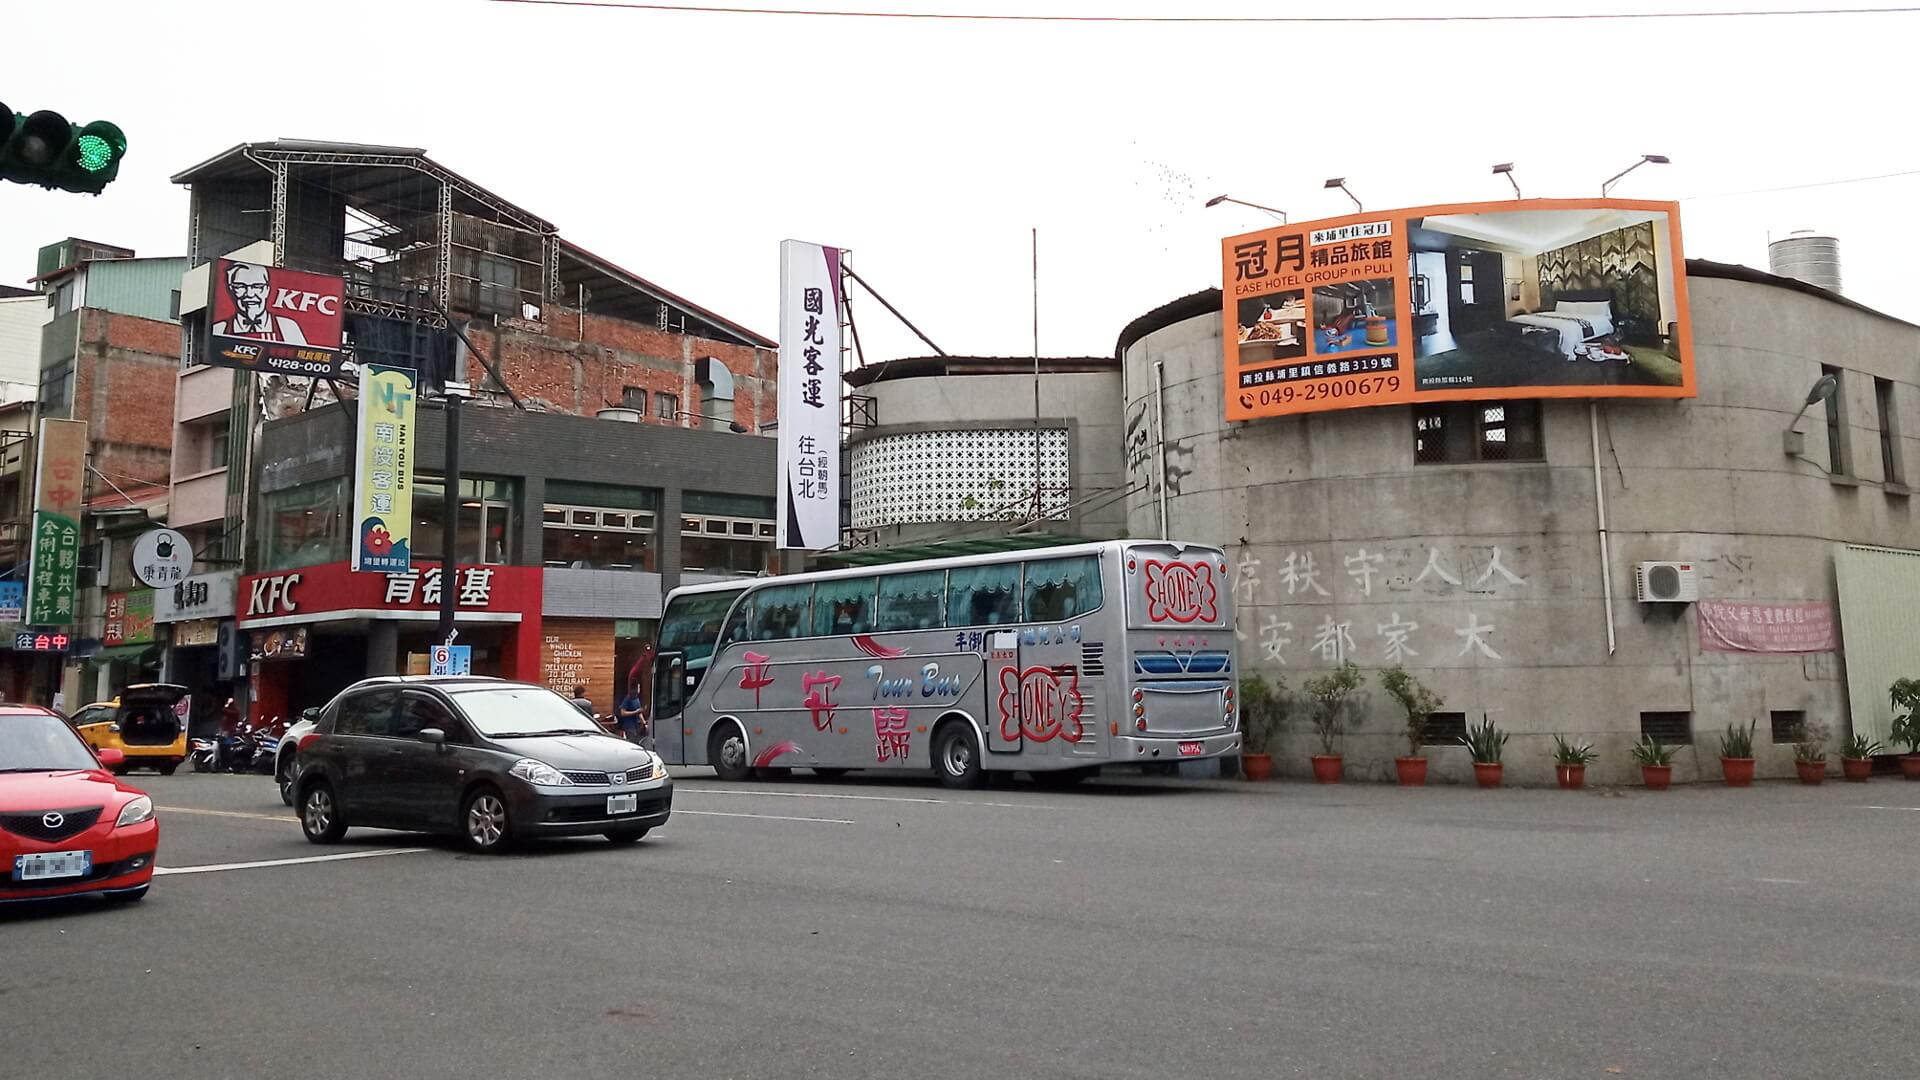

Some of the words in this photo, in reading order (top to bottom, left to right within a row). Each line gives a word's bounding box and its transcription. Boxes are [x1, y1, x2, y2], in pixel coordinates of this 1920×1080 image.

[1313, 223, 1389, 244] 來埔里住冠月
[1234, 233, 1305, 281] 冠月
[1310, 240, 1392, 268] 精品旅館
[1235, 281, 1262, 296] EASE
[1265, 276, 1300, 289] HOTEL
[1304, 268, 1348, 284] GROUP
[1351, 266, 1360, 277] in
[1364, 263, 1393, 274] PULI
[272, 288, 338, 316] KFC
[233, 344, 258, 356] KFC
[802, 286, 825, 409] 國光客運
[268, 357, 331, 374] 4128-000
[373, 381, 412, 420] NT
[1259, 376, 1400, 406] 049-2900679
[398, 424, 407, 446] NAN
[371, 422, 395, 515] 南投客運
[398, 448, 406, 468] TOU
[797, 434, 816, 500] 往台北
[47, 458, 76, 509] 台中
[397, 470, 405, 491] BUS
[246, 573, 300, 616] KFC
[1157, 571, 1205, 612] HONEY
[17, 634, 68, 650] 往台中
[437, 650, 447, 662] 6
[866, 664, 913, 700] Tour
[920, 662, 960, 698] Bus
[1011, 677, 1067, 733] HONEY
